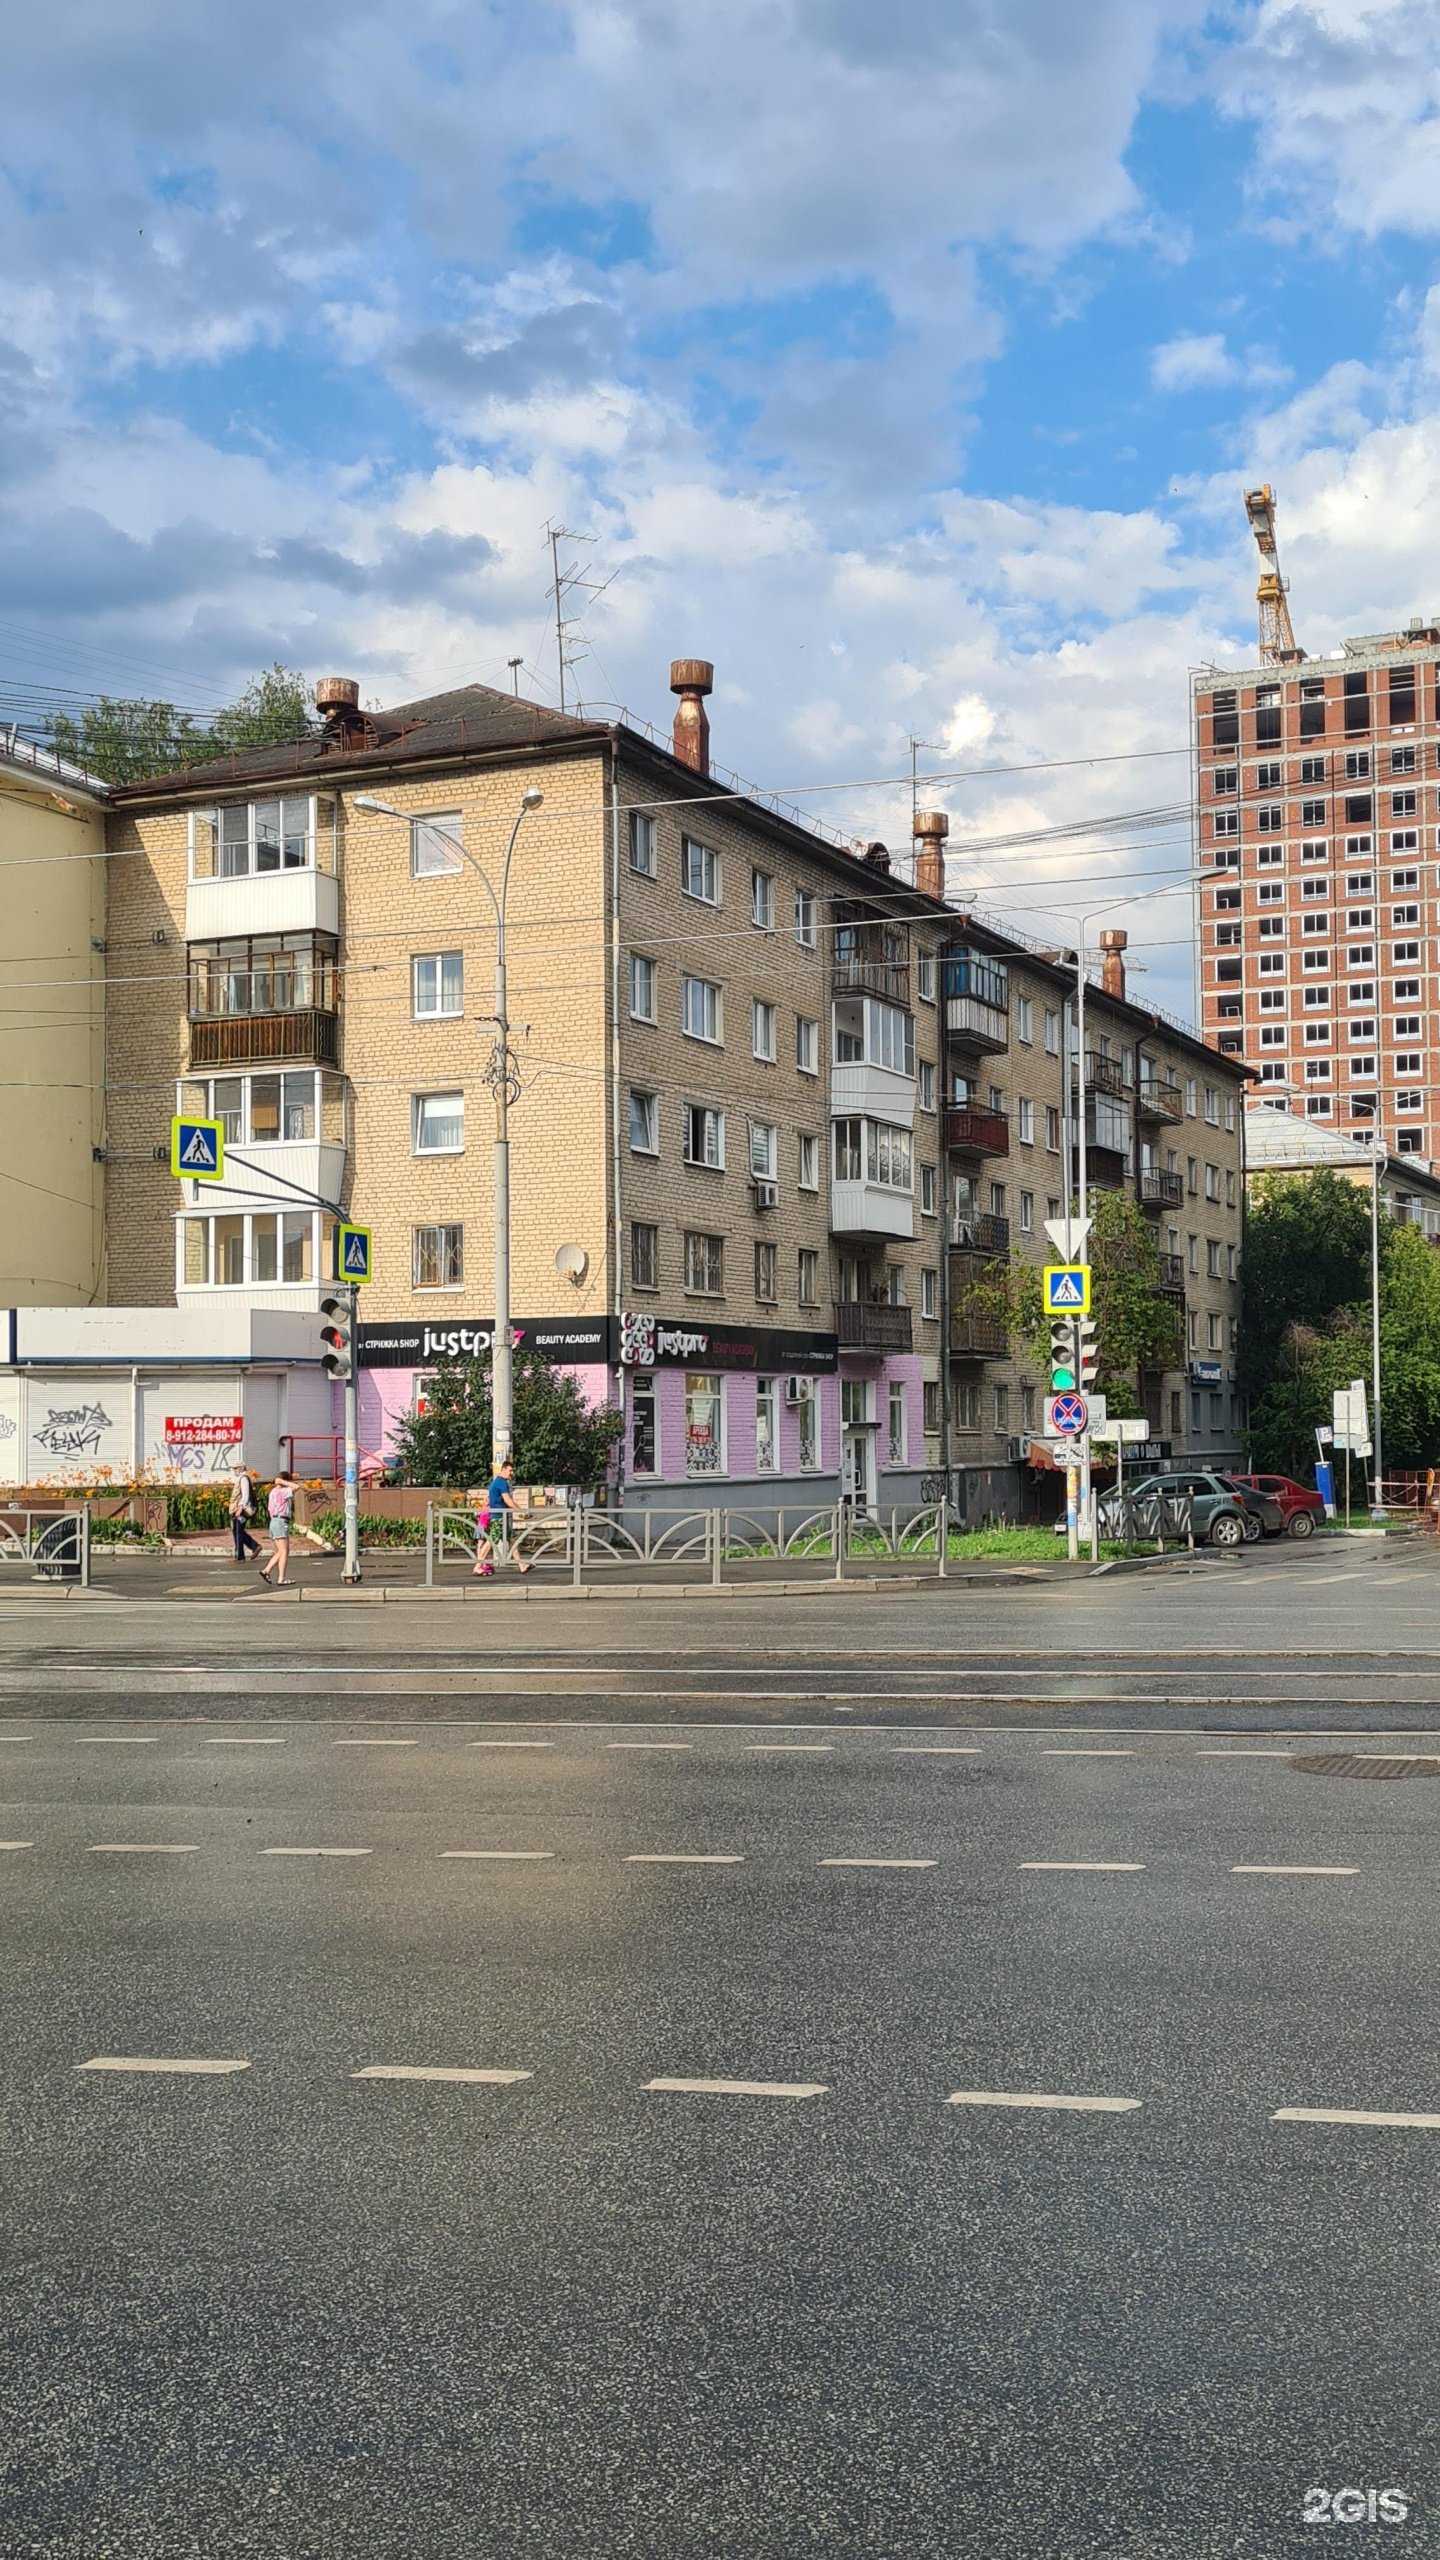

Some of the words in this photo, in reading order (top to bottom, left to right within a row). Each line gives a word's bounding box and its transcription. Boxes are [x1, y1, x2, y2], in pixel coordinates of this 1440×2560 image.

[400, 1339, 420, 1348] SHOP
[423, 1327, 527, 1357] justp
[536, 1335, 564, 1344] BEAUTY
[565, 1333, 601, 1344] ACADEMY
[657, 1326, 709, 1358] justpro
[173, 1418, 235, 1428] ПРОДАМ
[166, 1430, 242, 1441] 8-912-284-80-74
